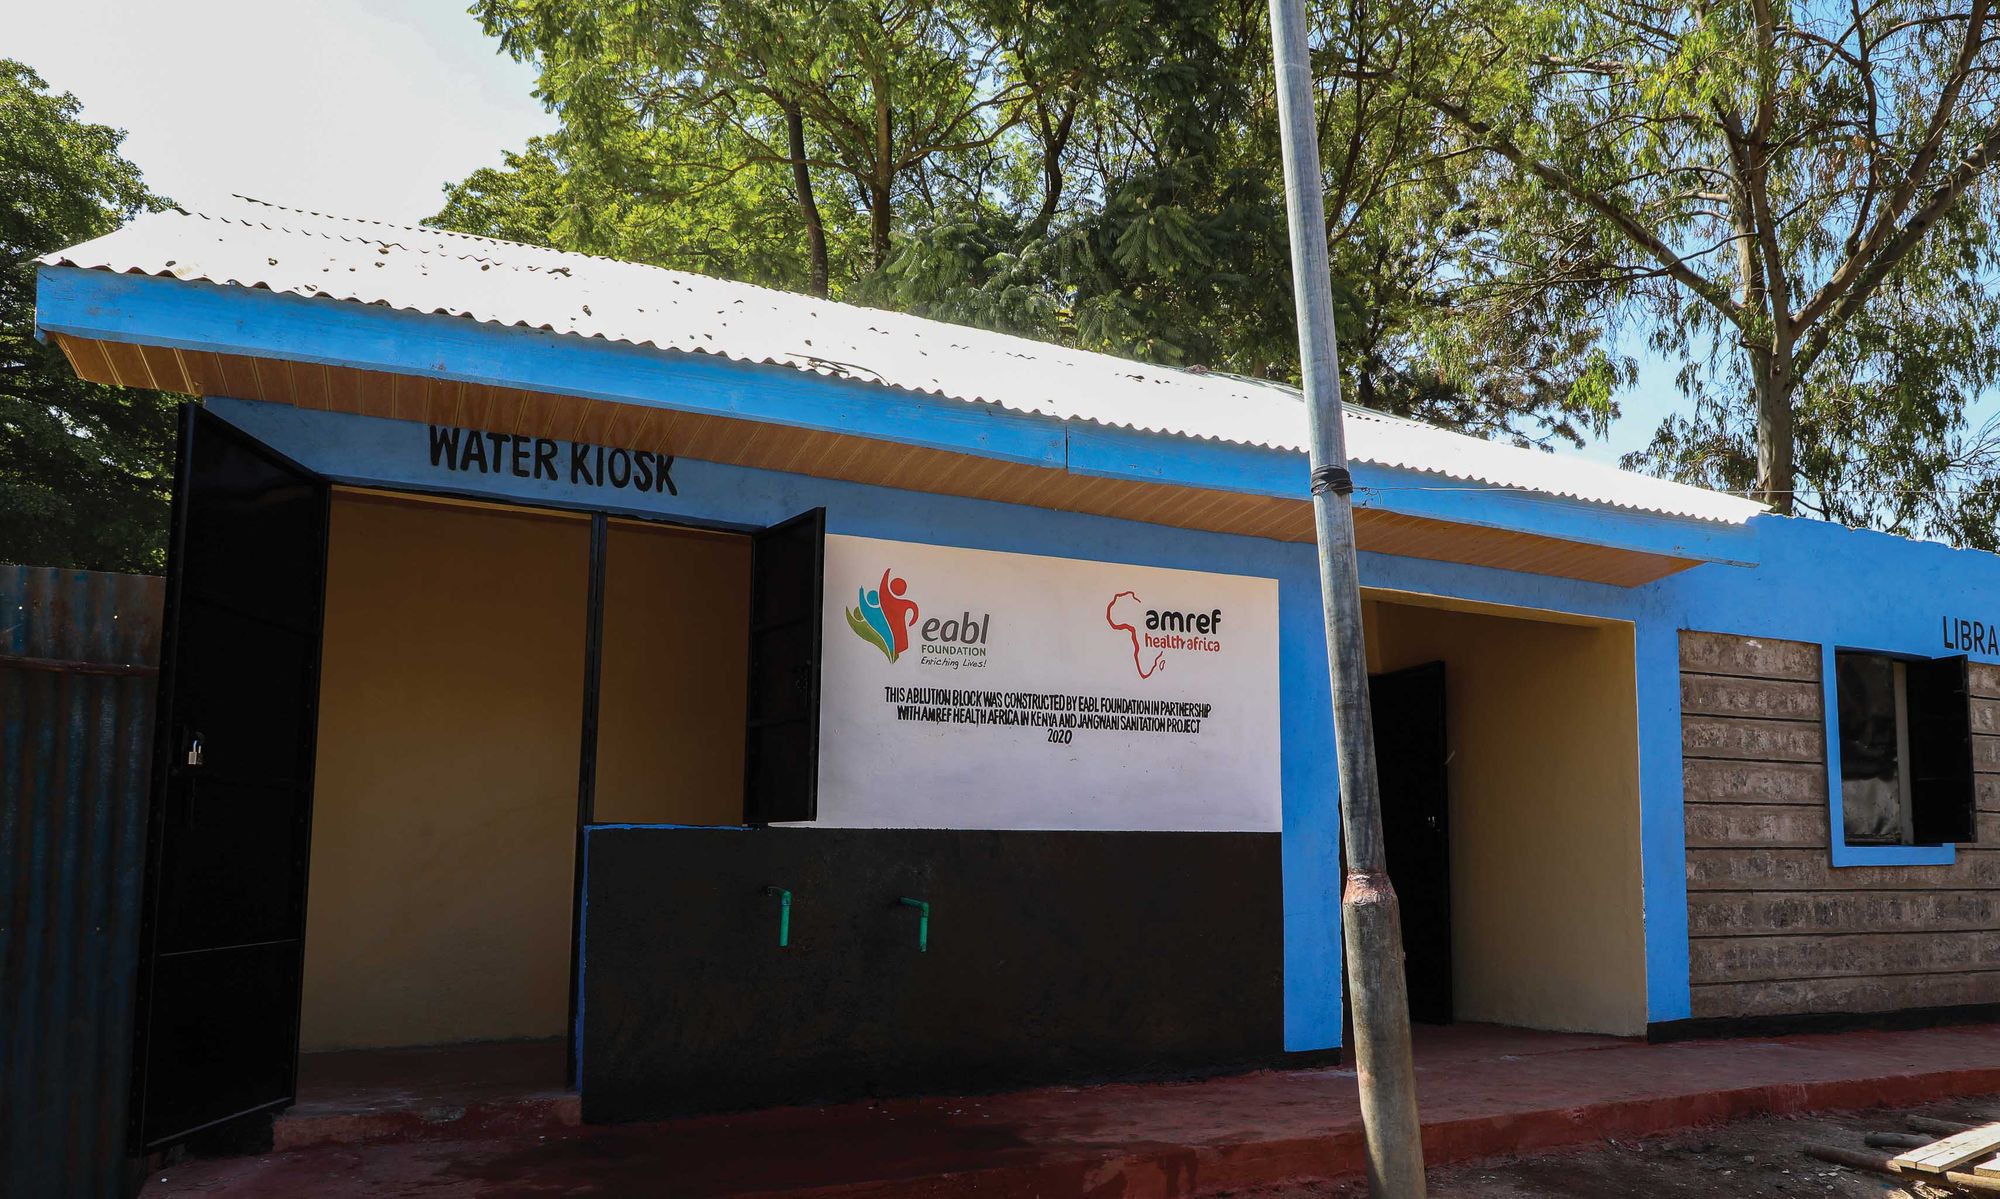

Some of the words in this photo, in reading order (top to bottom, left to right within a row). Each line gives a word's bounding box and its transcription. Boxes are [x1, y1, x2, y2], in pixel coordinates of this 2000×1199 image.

[429, 424, 559, 481] WATER
[570, 442, 678, 496] KIOSK
[922, 612, 989, 644] eabl
[1146, 609, 1221, 634] amref
[1943, 616, 2000, 656] LIBRA
[920, 656, 959, 669] Enriching
[962, 658, 987, 669] Lives!
[921, 645, 987, 656] FOUNDATION
[885, 687, 905, 702] THIS
[907, 687, 951, 705] ABLUTION
[952, 690, 983, 707] BLOCK
[983, 691, 1003, 708] WAS
[1004, 692, 1066, 711] CONSTRUCTED
[1066, 695, 1078, 711] BY
[1078, 696, 1099, 712] EABL
[1100, 697, 1150, 715] FOUNDATION
[1151, 700, 1160, 715] IN
[1160, 701, 1212, 718] PARTNERSHIP
[896, 705, 920, 720] WITH
[921, 706, 952, 723] AMREF
[952, 708, 987, 724] HEALTH
[987, 709, 1019, 726] AFRICA
[1020, 710, 1029, 726] IN
[1030, 711, 1057, 727] KENYA
[1058, 713, 1077, 728] AND
[1077, 714, 1120, 730] JANGWANI
[1120, 716, 1166, 732] SANITATION
[1166, 718, 1201, 734] PROJECT
[1047, 728, 1073, 745] 2020
